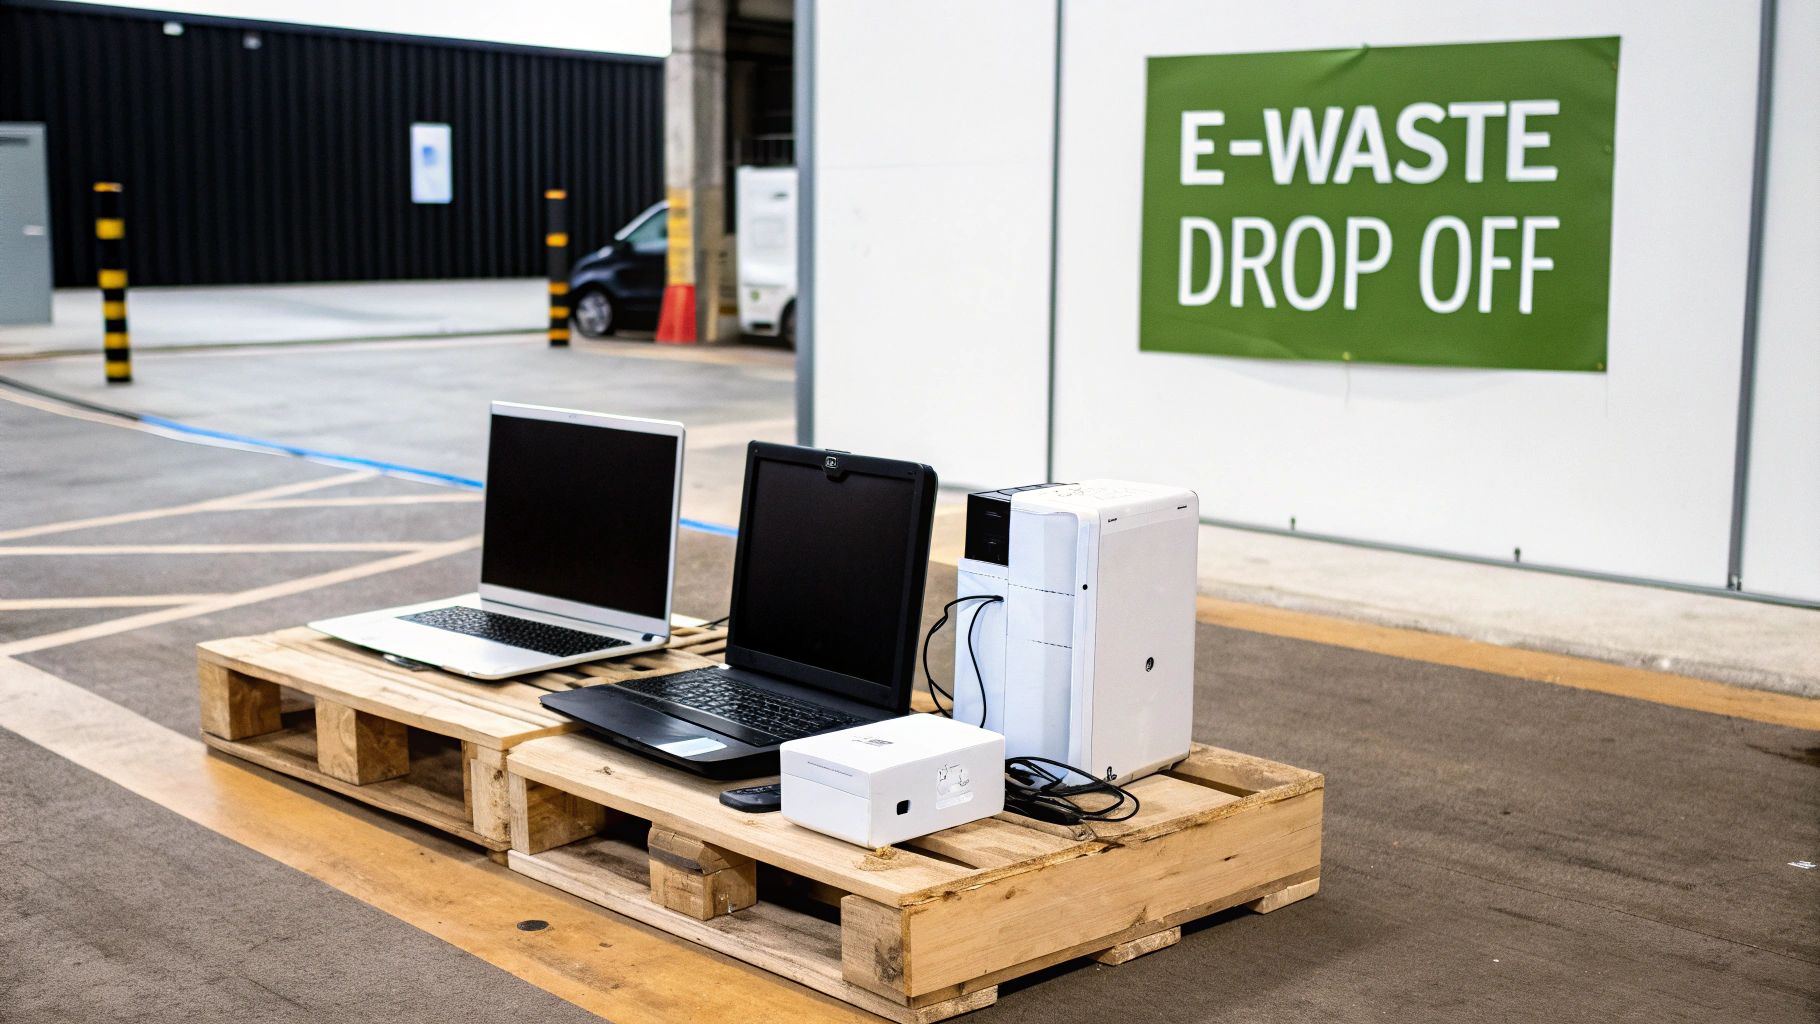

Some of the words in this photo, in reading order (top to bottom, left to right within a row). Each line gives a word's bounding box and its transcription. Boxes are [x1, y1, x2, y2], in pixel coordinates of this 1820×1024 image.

[1180, 99, 1560, 186] E-WASTE
[1178, 215, 1393, 311] DROP
[1419, 215, 1561, 315] OFF
